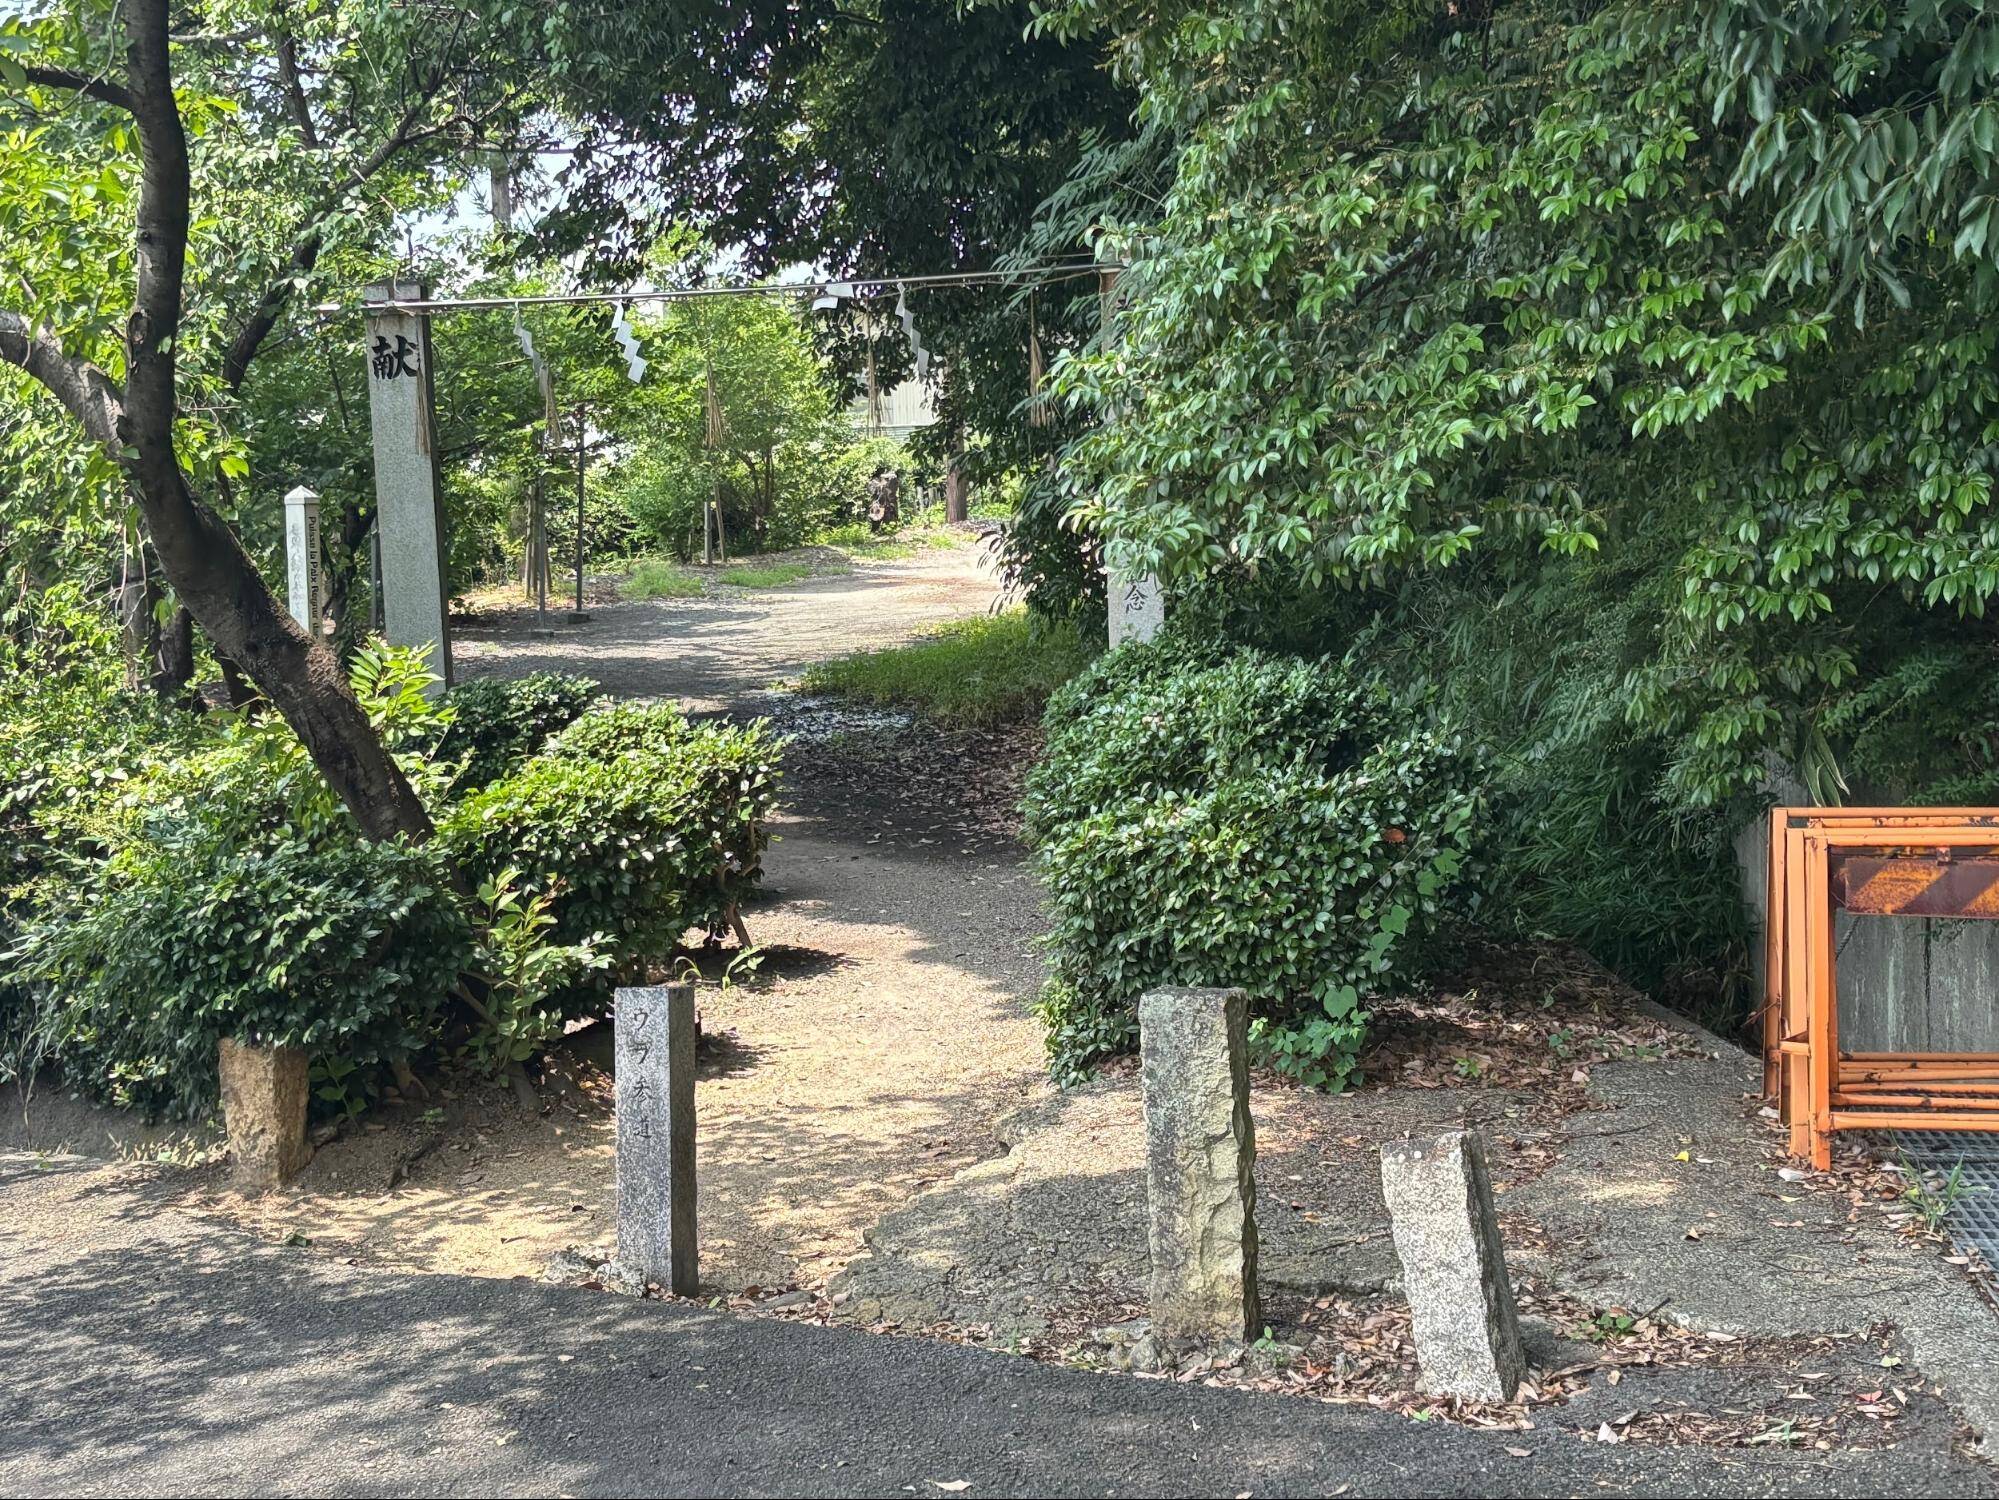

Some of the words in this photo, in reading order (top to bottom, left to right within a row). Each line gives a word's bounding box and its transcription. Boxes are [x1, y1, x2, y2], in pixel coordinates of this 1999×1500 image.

[371, 334, 419, 380] 献
[309, 516, 317, 549] Puisse
[310, 551, 318, 560] la
[310, 561, 319, 583] Paix
[1124, 569, 1149, 614] 念
